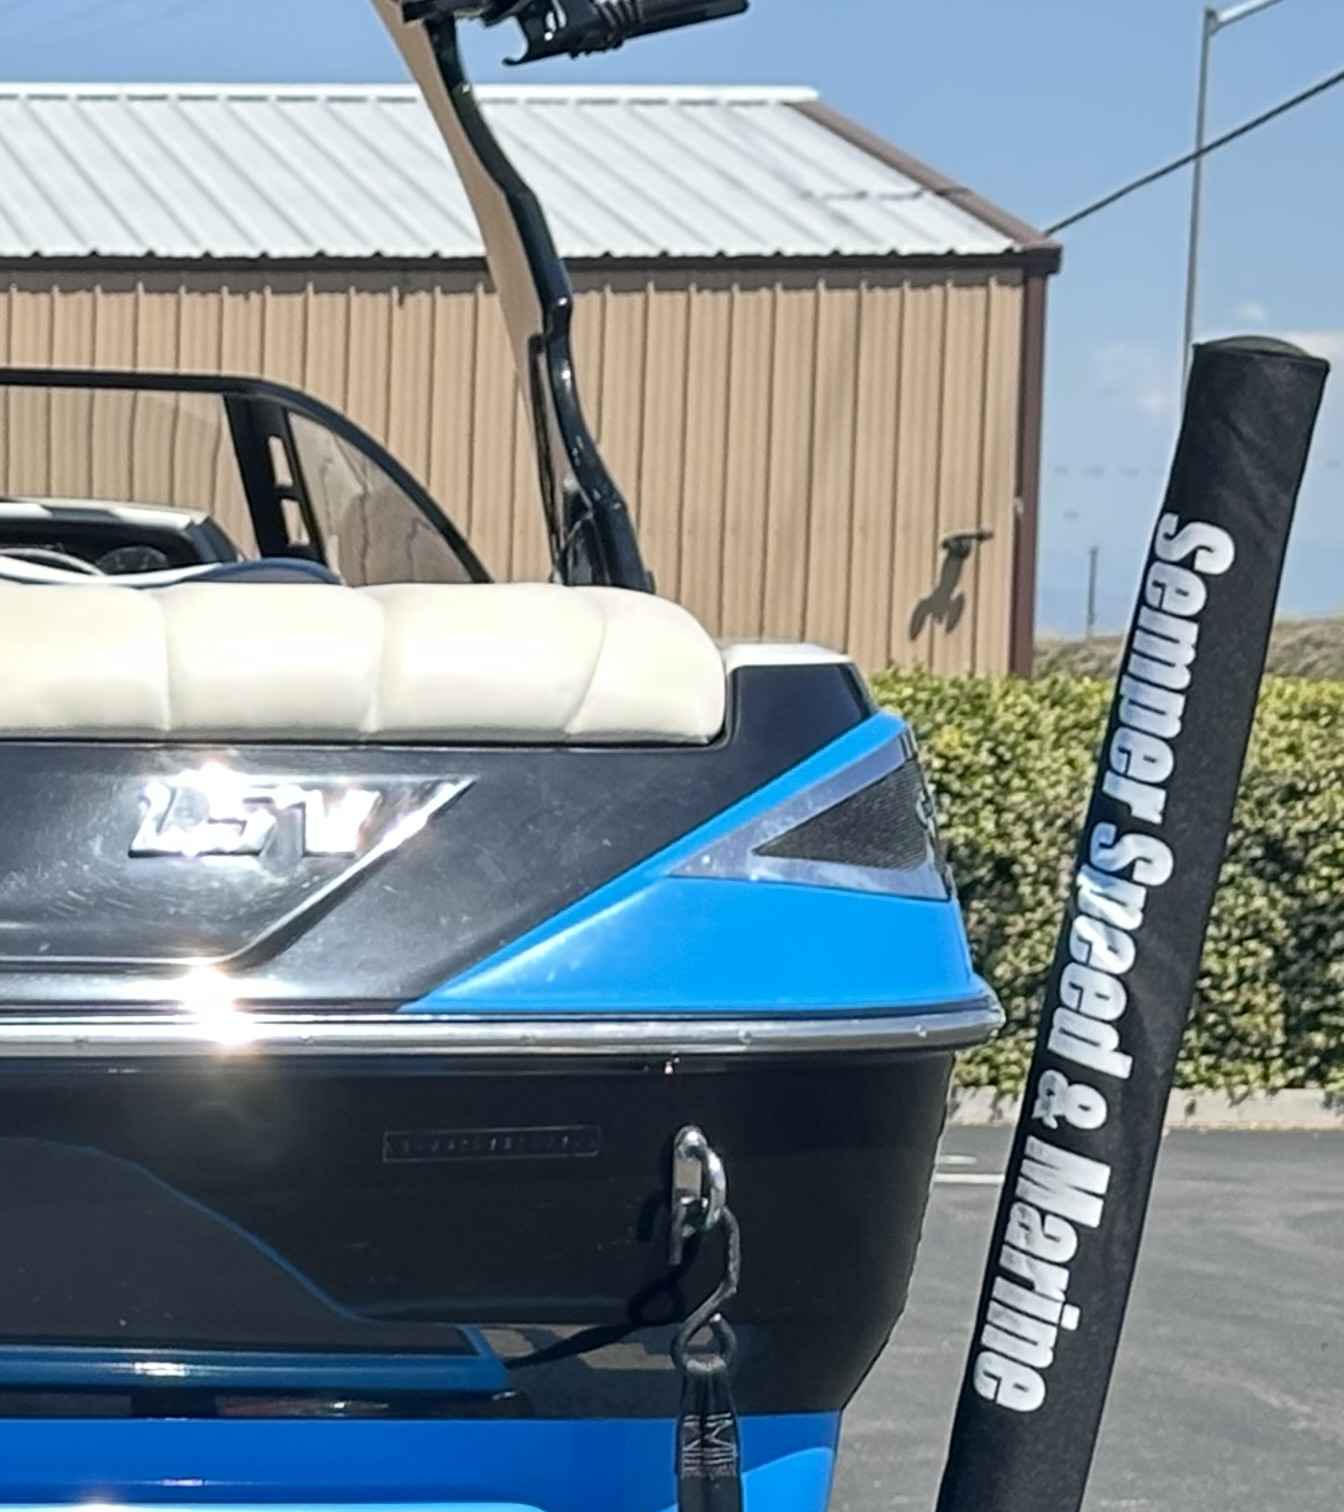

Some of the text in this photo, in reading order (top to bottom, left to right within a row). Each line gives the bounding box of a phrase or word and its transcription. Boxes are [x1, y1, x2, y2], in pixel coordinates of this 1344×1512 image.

[972, 513, 1235, 1412] Semper Speed & Marine
